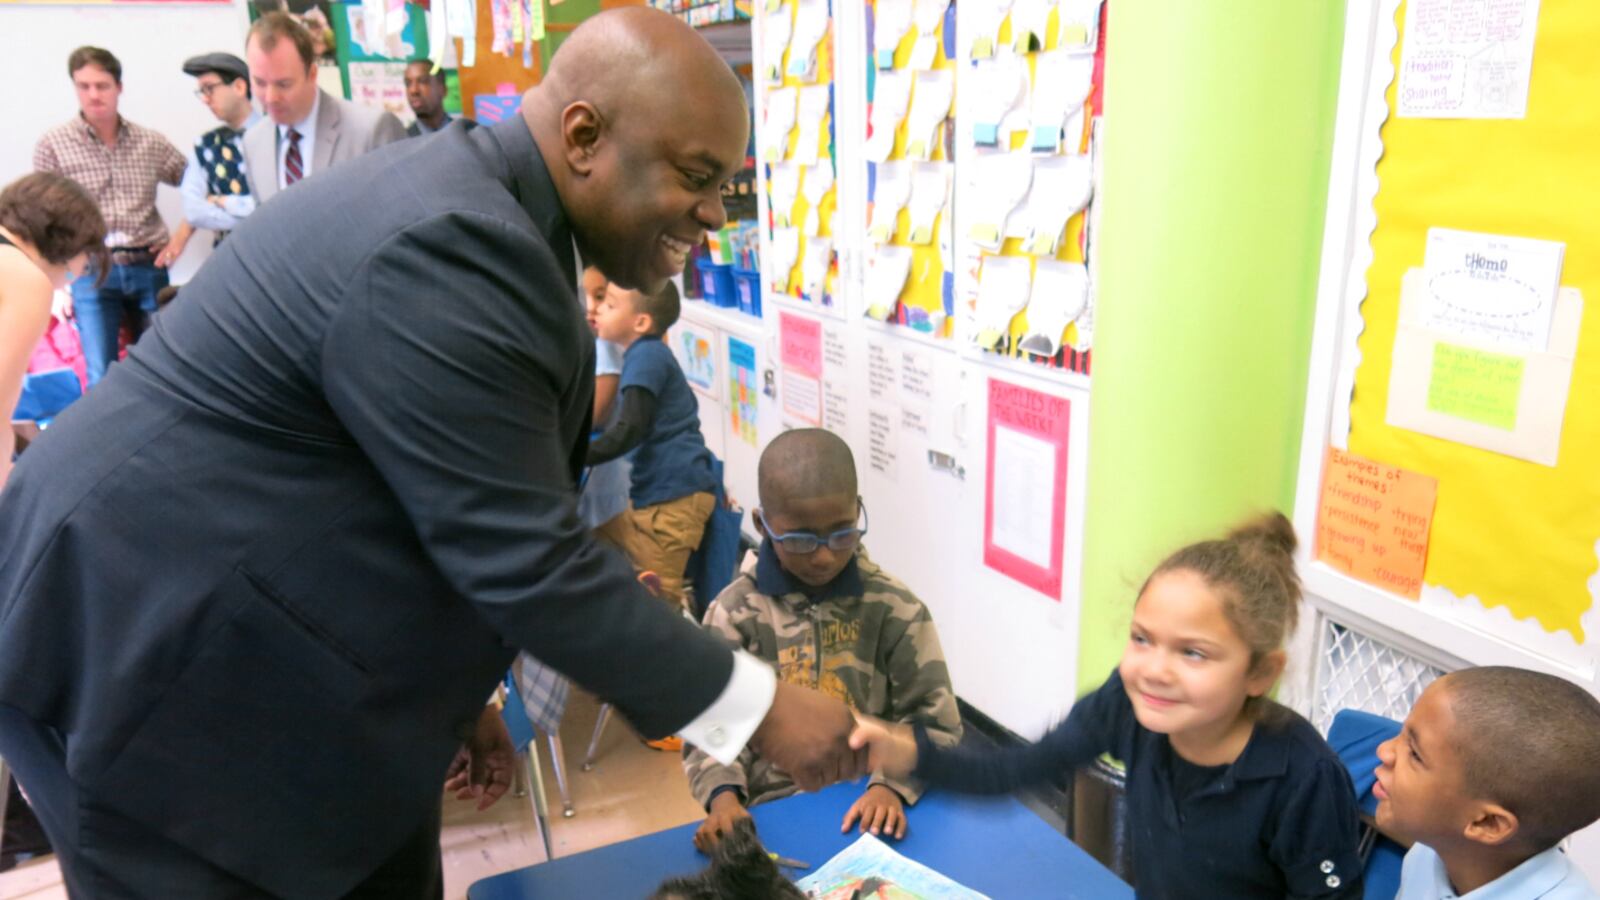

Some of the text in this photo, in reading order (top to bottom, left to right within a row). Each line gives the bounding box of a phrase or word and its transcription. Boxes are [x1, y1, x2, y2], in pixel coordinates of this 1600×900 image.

[991, 384, 1066, 417] FAMILIES OF
[994, 403, 1012, 423] THE
[1332, 449, 1403, 482] Examples of
[1376, 567, 1421, 595] courage
